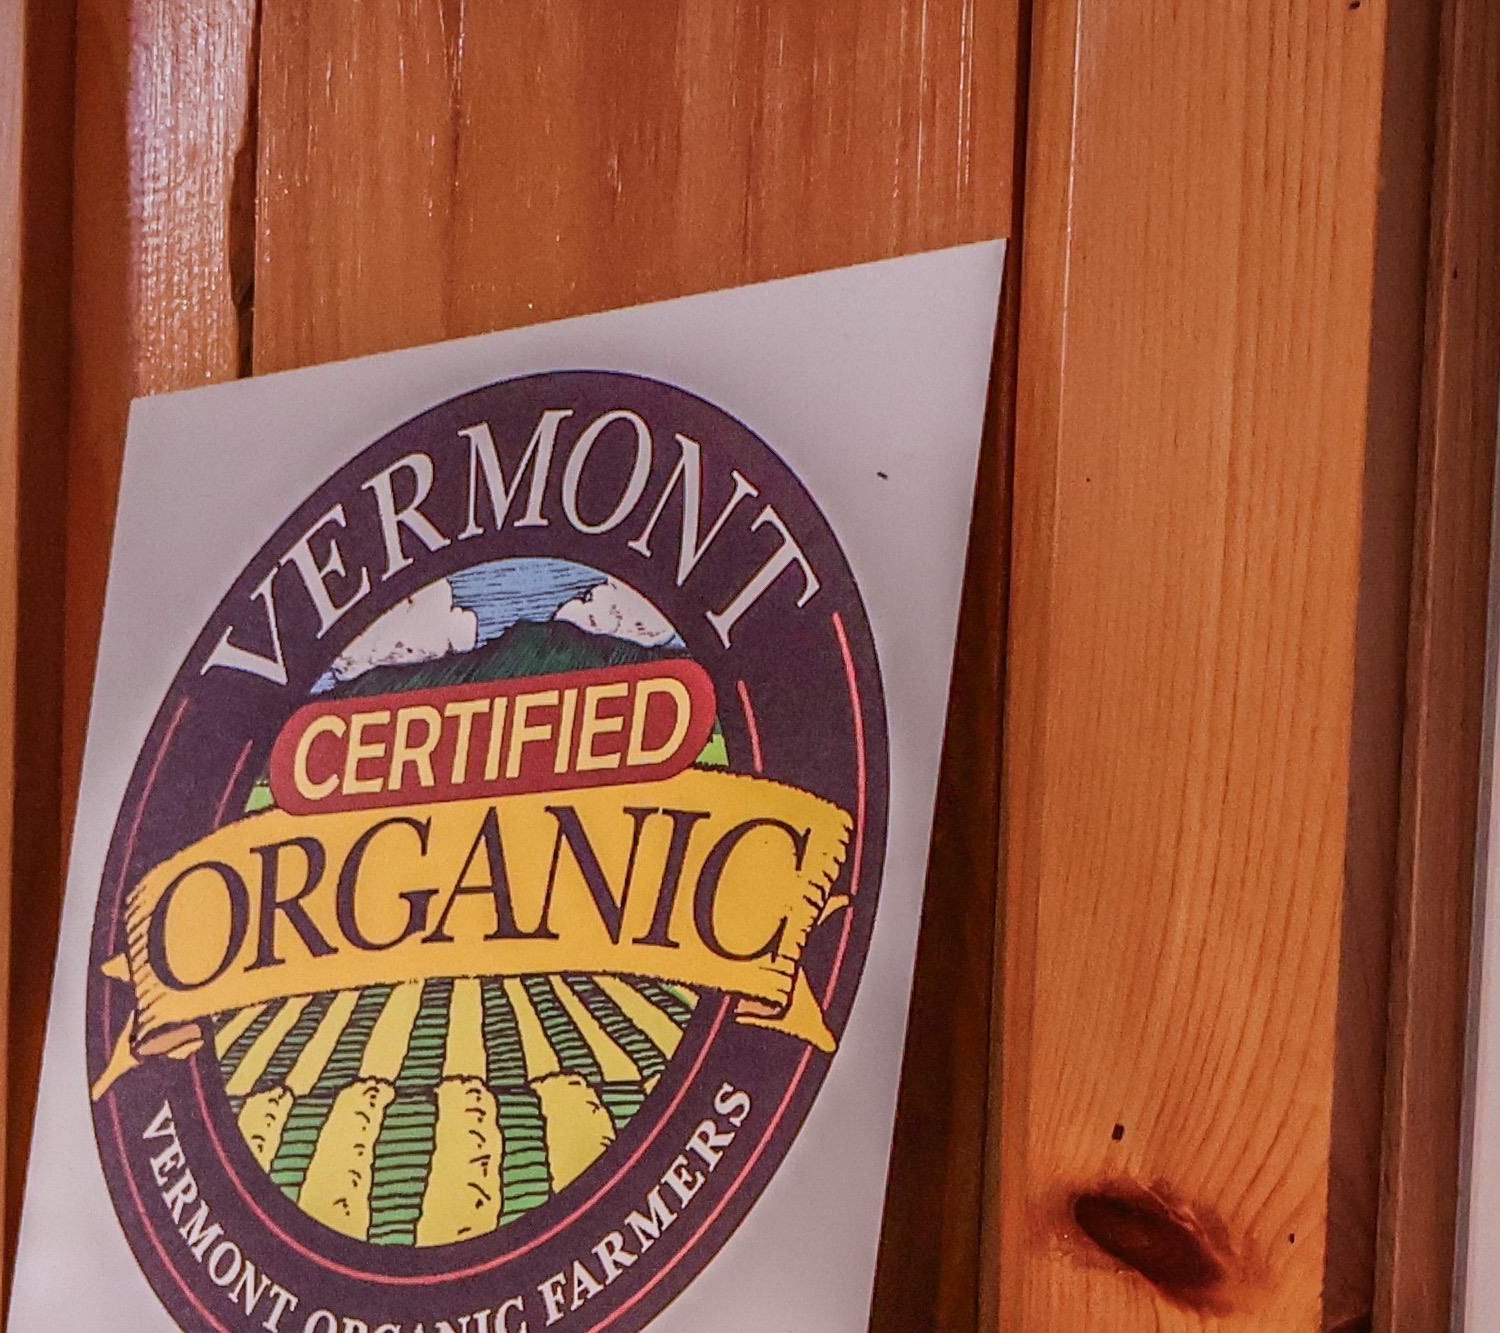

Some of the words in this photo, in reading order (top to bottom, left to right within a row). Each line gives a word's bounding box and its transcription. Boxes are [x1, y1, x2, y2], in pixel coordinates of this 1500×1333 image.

[200, 408, 822, 689] VERMONT
[293, 676, 693, 801] CERTIFIED
[148, 805, 811, 993] ORGANIC
[541, 1081, 753, 1328] FARMERS
